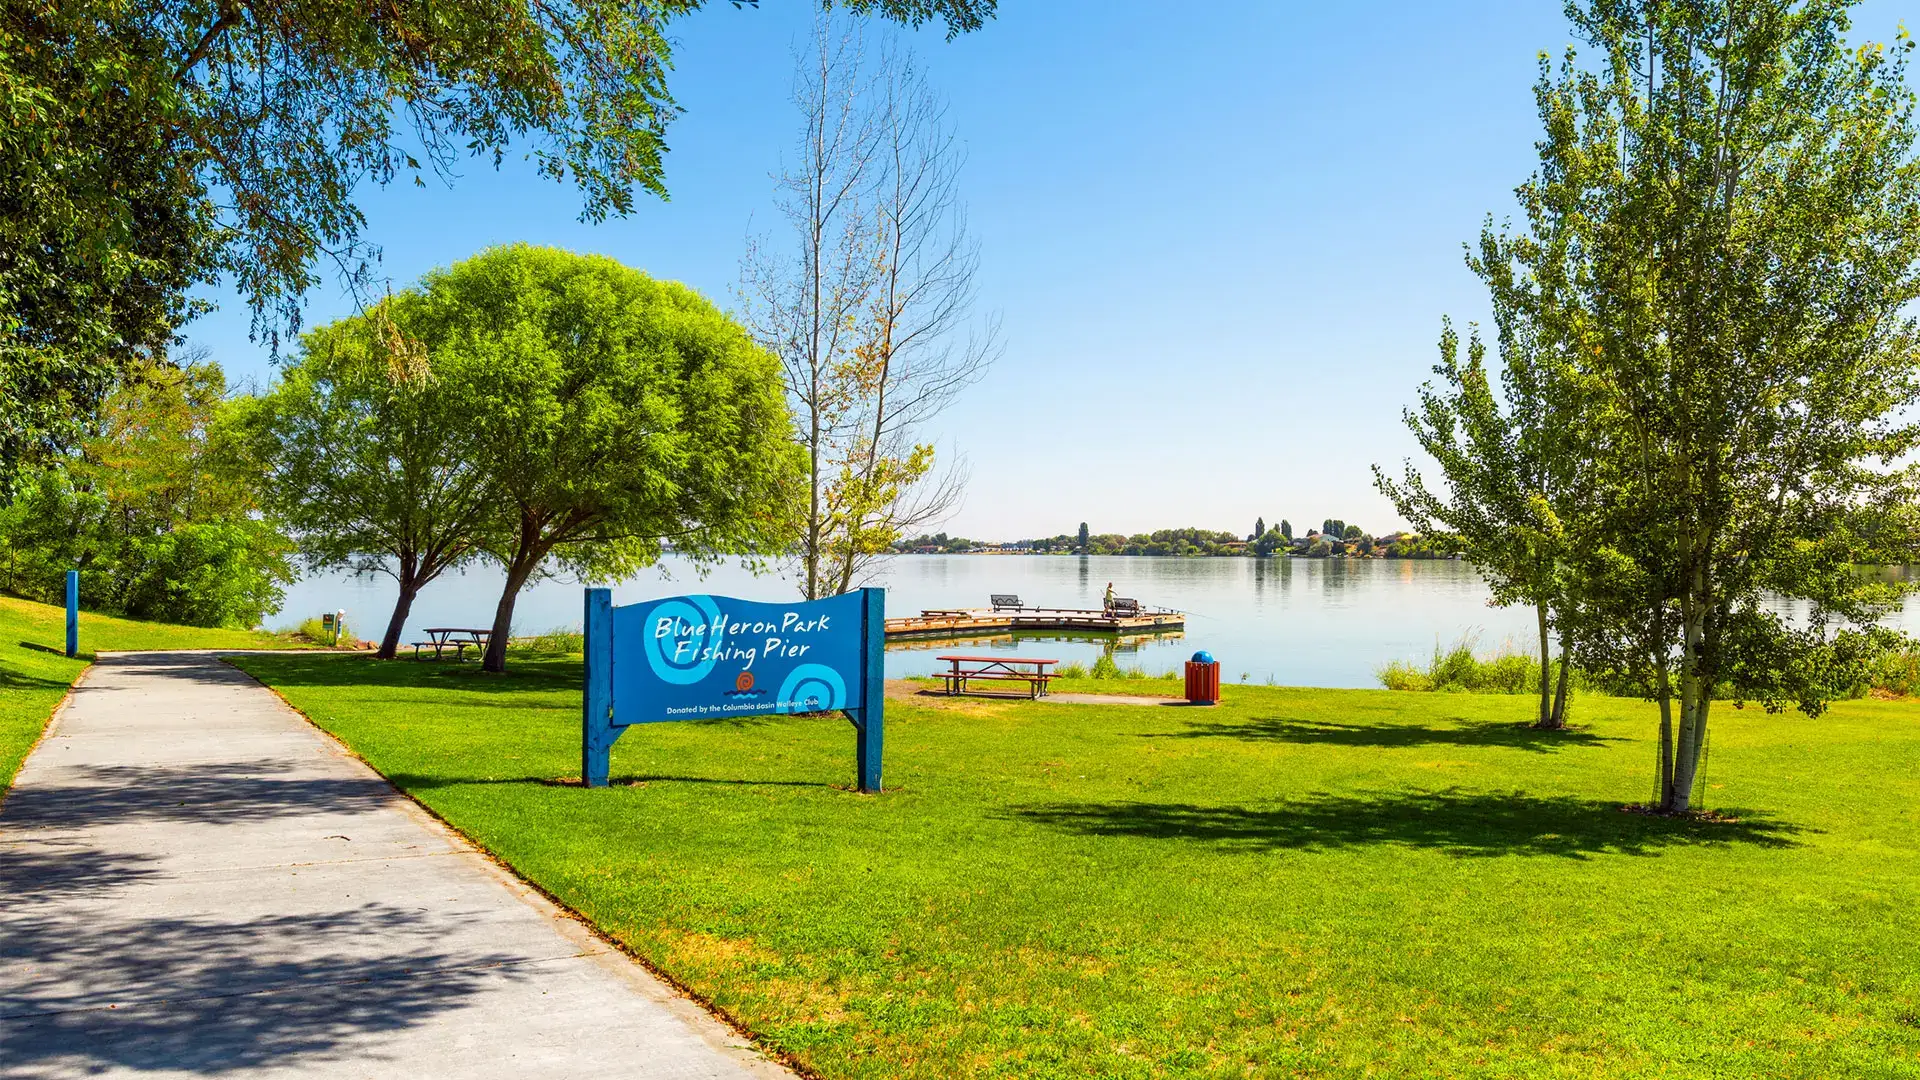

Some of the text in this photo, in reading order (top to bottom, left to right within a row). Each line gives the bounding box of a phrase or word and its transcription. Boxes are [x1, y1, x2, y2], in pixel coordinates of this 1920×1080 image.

[655, 612, 830, 638] Blue Heron Park
[674, 637, 810, 670] Fishing Pier
[666, 705, 698, 714] Donated
[699, 705, 708, 714] by
[709, 704, 721, 712] the
[722, 702, 755, 711] Columbia
[804, 697, 819, 706] Club
